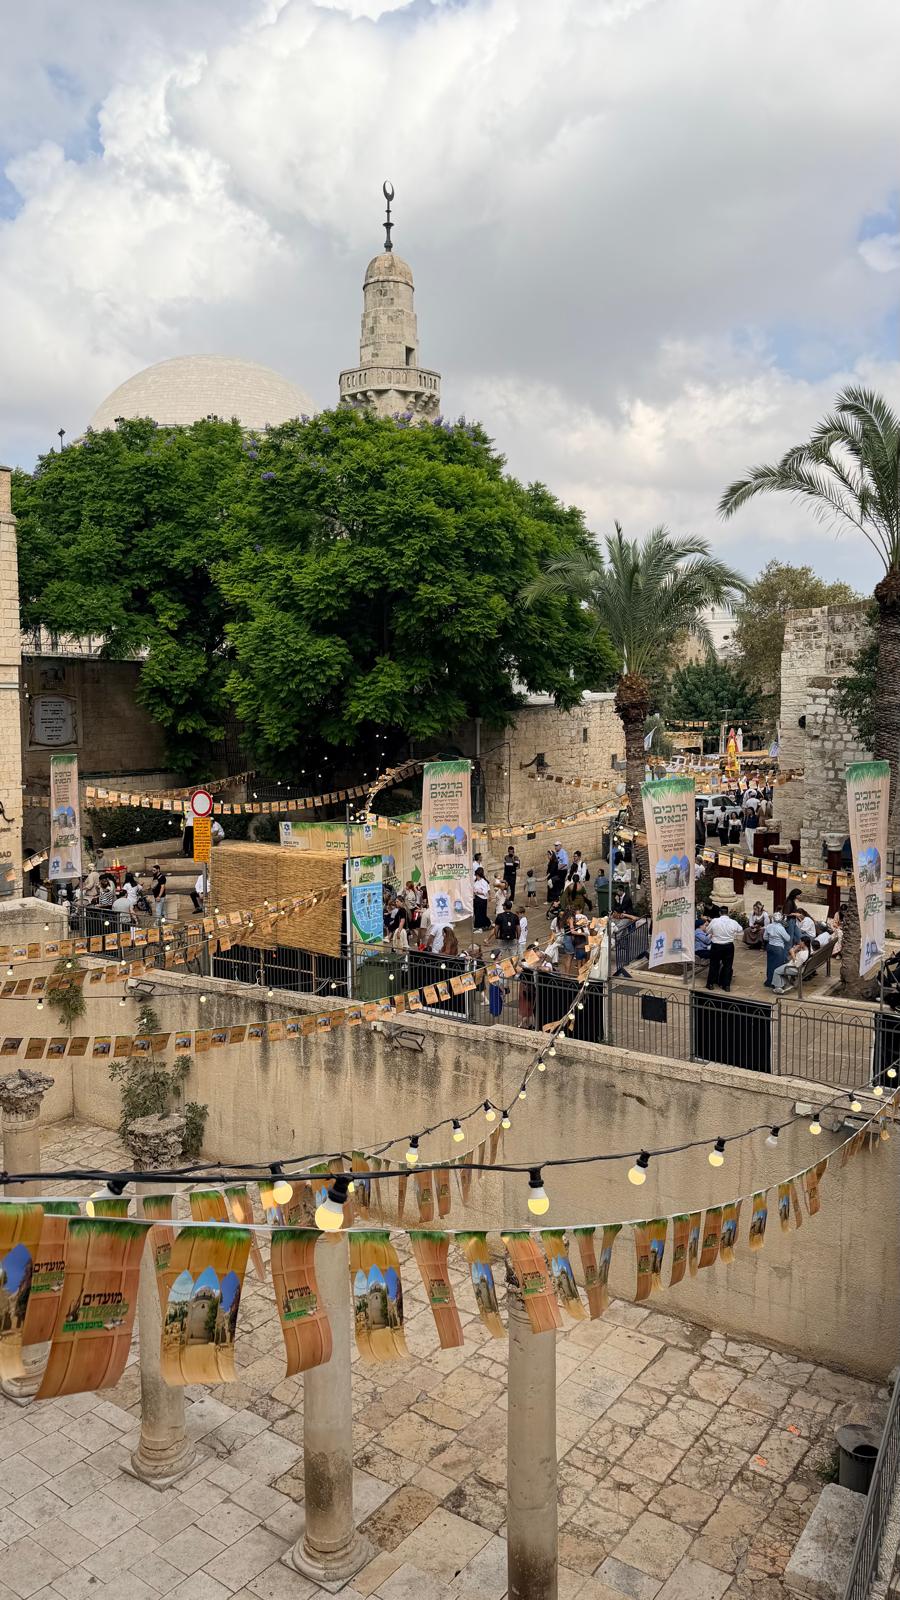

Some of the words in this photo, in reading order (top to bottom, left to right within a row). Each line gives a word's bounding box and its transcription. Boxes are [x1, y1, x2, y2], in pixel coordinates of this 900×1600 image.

[430, 781, 463, 791] ברוכים
[430, 790, 463, 799] הבאים
[652, 803, 688, 815] ברוכים
[654, 813, 688, 824] הבאים
[33, 1260, 65, 1273] מועדים
[82, 1291, 123, 1306] מועדים
